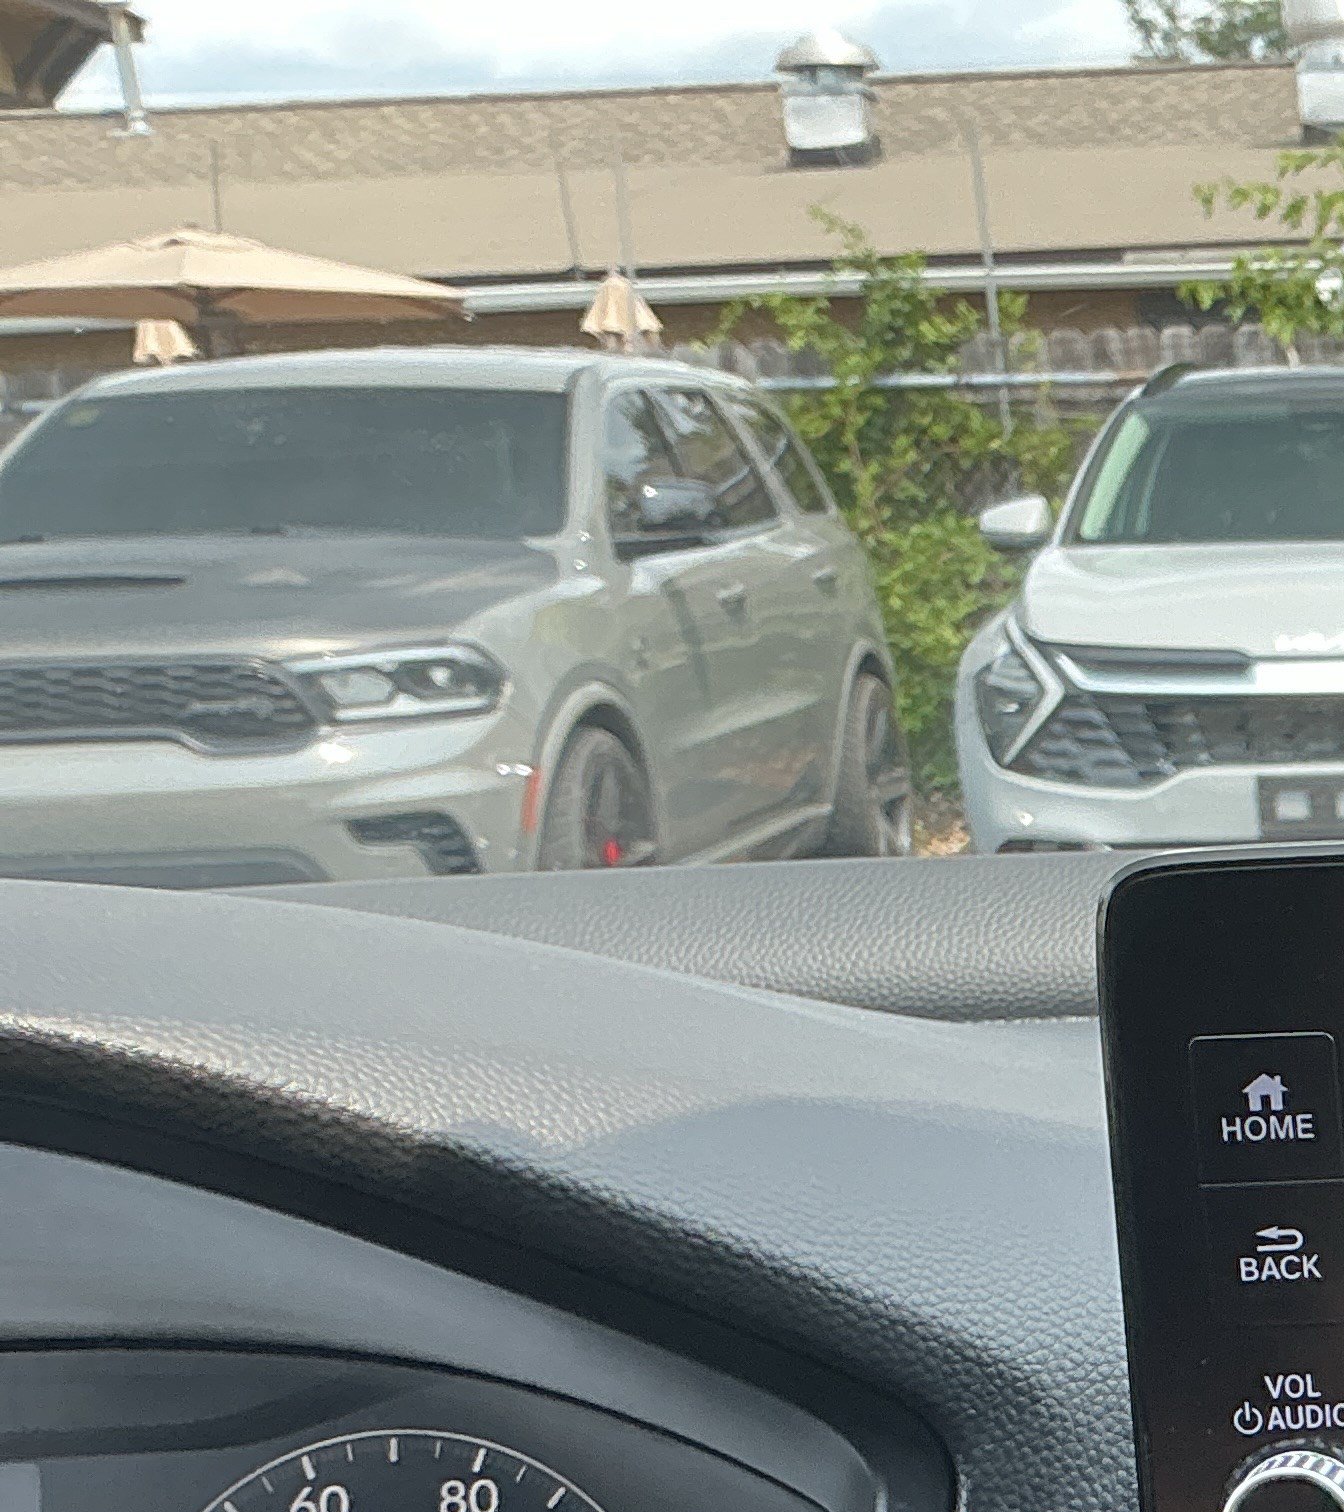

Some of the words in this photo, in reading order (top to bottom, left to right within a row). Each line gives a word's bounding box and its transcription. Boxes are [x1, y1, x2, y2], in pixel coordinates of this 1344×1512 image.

[1221, 1113, 1315, 1142] HOME
[1239, 1254, 1322, 1282] BACK
[1264, 1373, 1322, 1399] VOL
